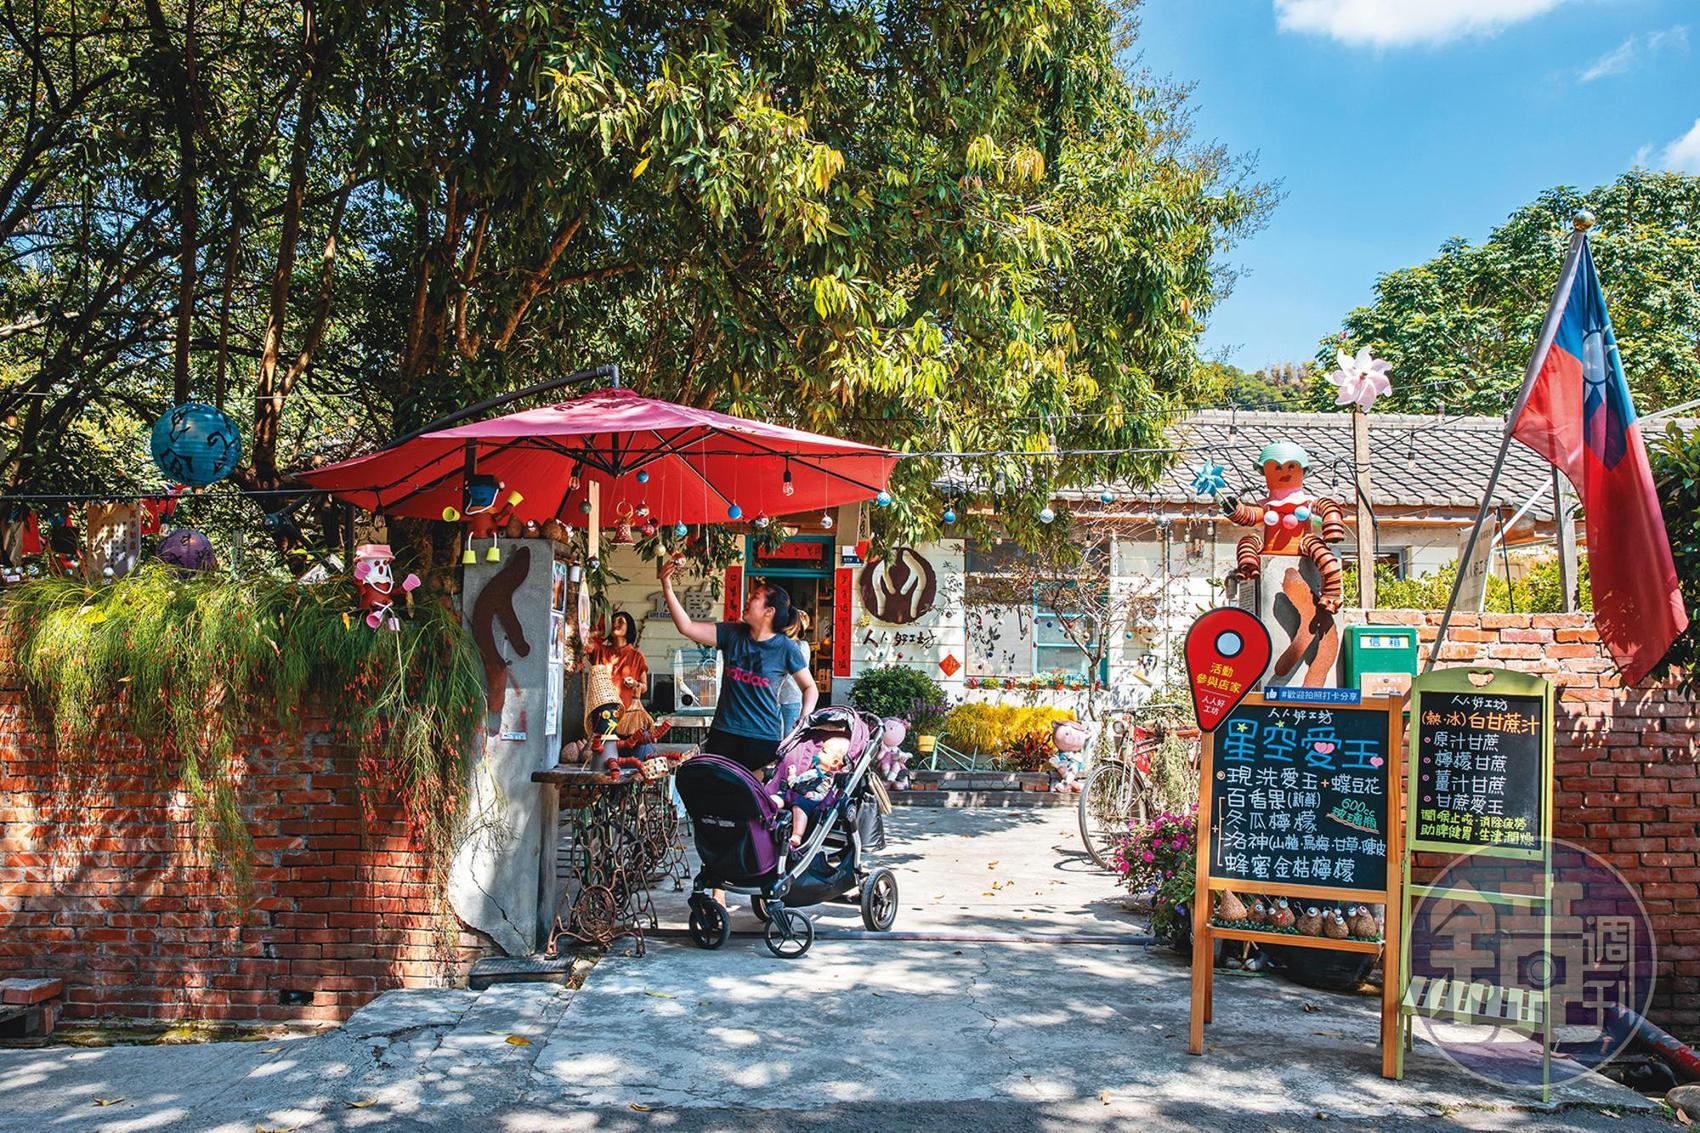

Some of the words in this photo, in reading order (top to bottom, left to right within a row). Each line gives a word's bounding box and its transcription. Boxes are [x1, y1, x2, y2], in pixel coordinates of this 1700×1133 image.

[1210, 662, 1234, 678] 活動
[1196, 672, 1242, 694] 參與店家
[1202, 696, 1225, 708] 人人好
[1204, 705, 1219, 716] 工坊
[1451, 695, 1508, 711] 人人好工坊
[1268, 708, 1334, 725] 人人好工坊
[1433, 731, 1500, 752] 原汁甘蔗
[1434, 749, 1508, 772] 檸檬甘蔗
[1435, 769, 1507, 795] 薑汁甘蔗
[1341, 798, 1375, 817] 600cc
[1226, 809, 1317, 833] 冬瓜檸檬
[1225, 852, 1355, 883] 蜂蜜金桔檸檬
